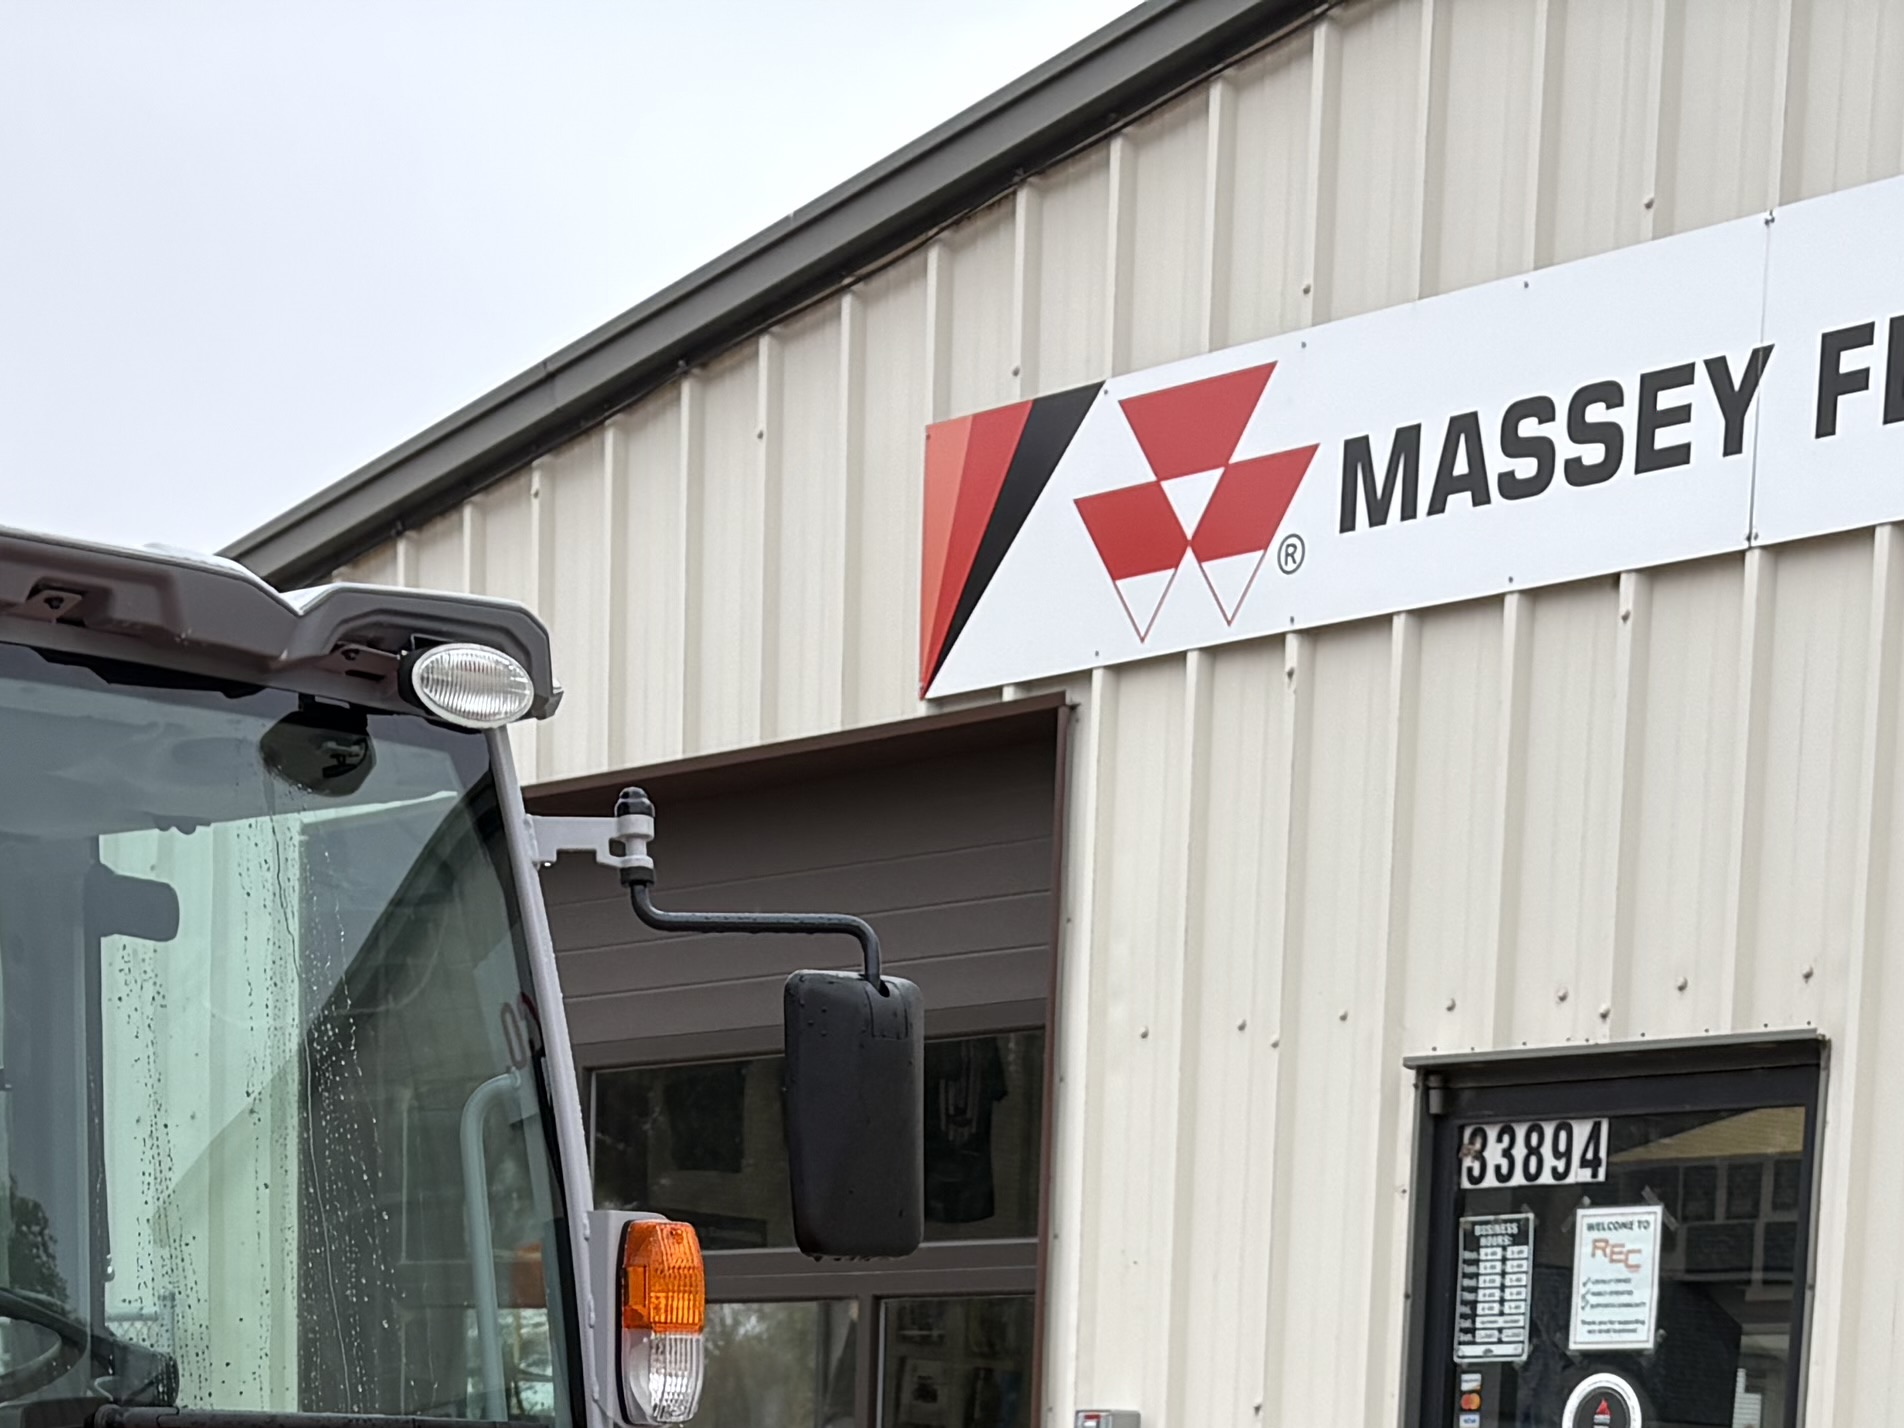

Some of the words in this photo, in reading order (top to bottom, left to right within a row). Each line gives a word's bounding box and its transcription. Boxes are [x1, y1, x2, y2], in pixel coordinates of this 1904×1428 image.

[1339, 345, 1773, 533] MASSEY
[1467, 1120, 1603, 1186] 33894
[1591, 1238, 1642, 1269] REC
